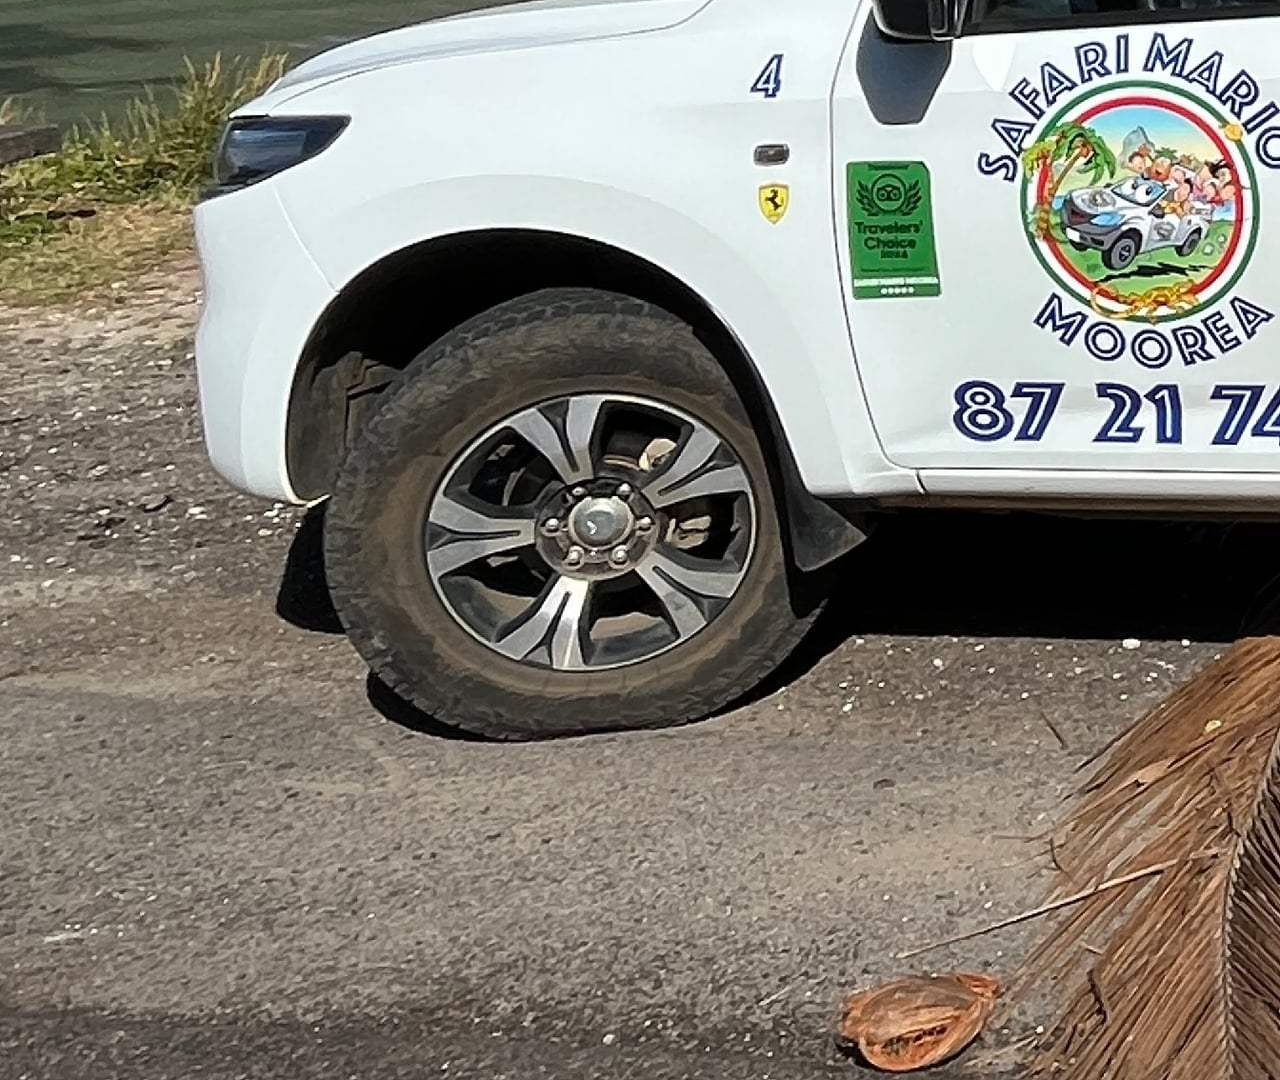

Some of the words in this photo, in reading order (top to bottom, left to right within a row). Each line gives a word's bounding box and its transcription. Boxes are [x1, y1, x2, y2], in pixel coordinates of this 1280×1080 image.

[750, 53, 784, 98] 4
[977, 32, 1130, 182] SAFARI
[864, 236, 916, 250] Choice
[1033, 293, 1275, 369] MOOREA
[953, 379, 1065, 441] 87
[1094, 383, 1183, 445] 21
